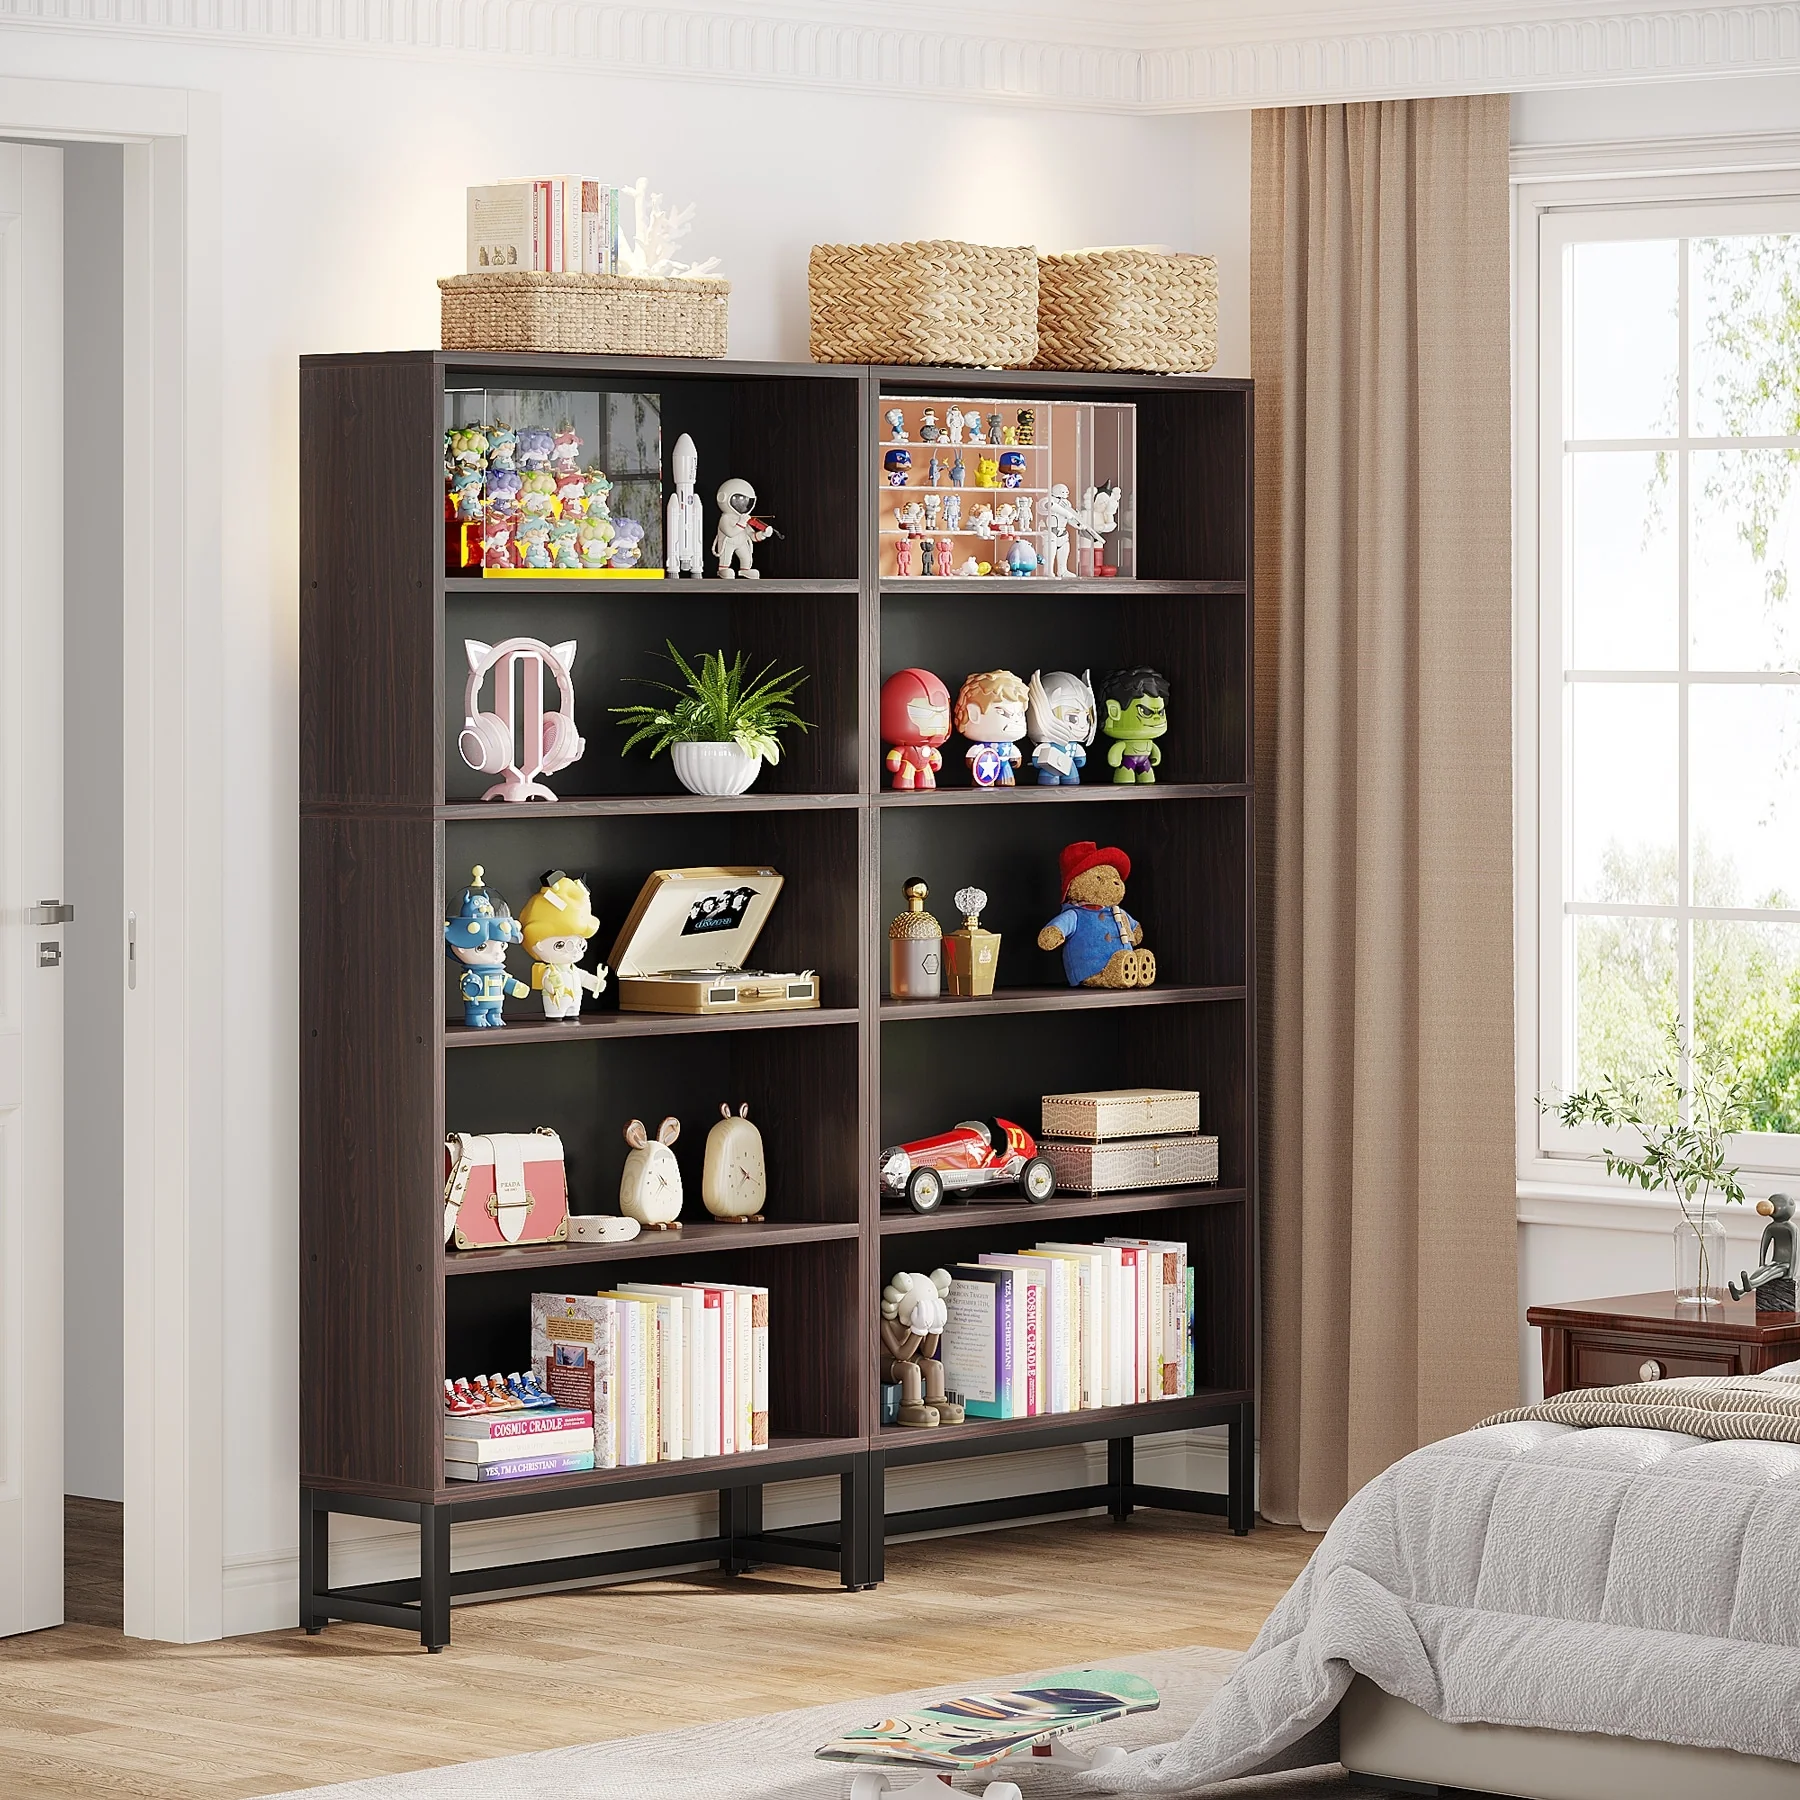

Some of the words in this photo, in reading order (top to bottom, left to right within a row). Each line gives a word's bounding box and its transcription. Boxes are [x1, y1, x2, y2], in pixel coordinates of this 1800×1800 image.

[1027, 1290, 1035, 1331] COSMIC
[1027, 1334, 1036, 1376] CRADLE
[494, 1421, 527, 1437] COSMIC
[529, 1417, 563, 1432] CRADLE
[485, 1466, 500, 1477] YES,
[512, 1465, 517, 1474] A
